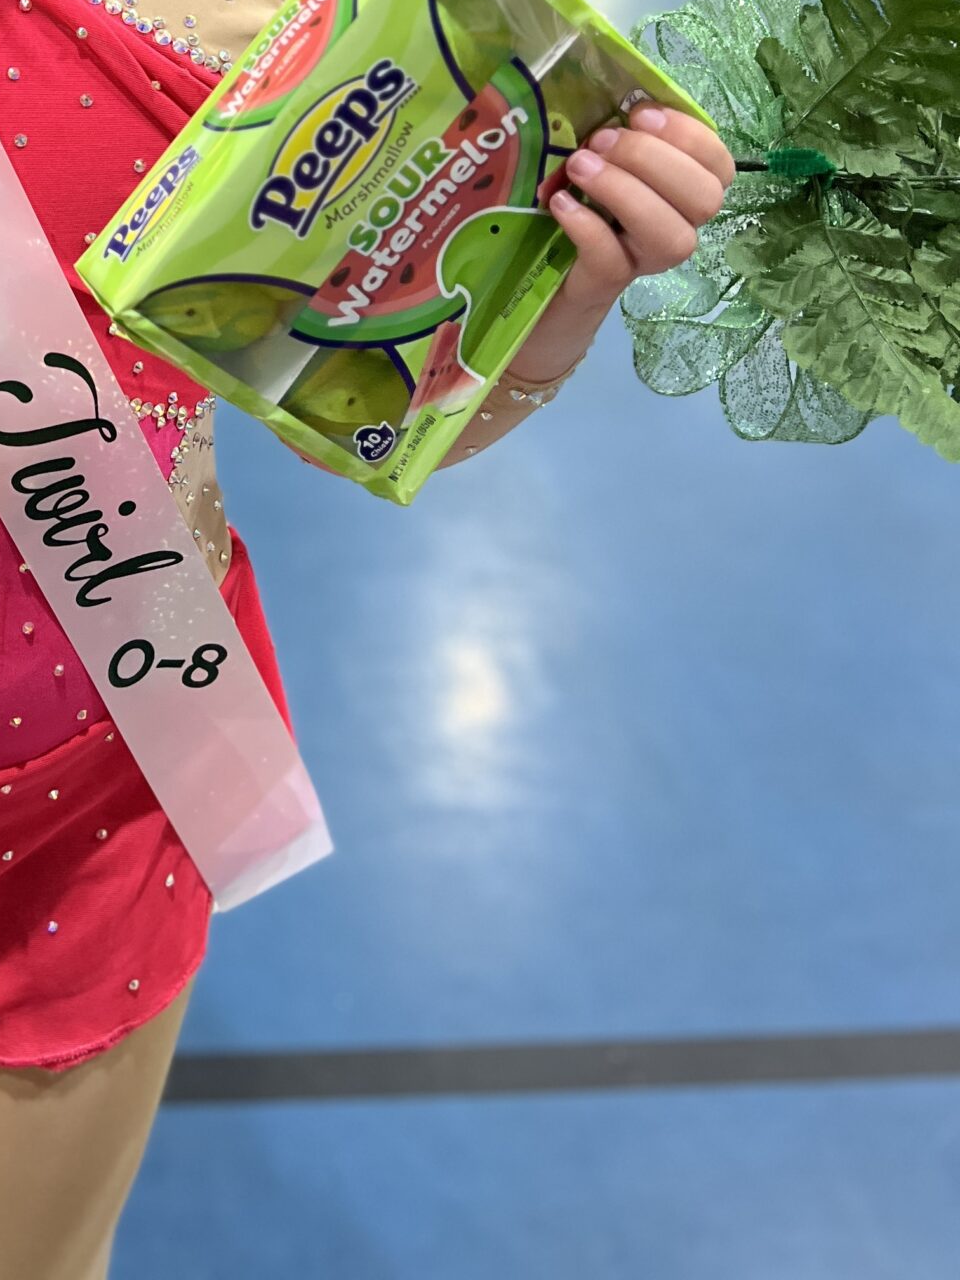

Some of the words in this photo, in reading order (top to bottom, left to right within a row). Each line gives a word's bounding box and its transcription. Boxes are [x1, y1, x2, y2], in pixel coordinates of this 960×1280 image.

[242, 0, 306, 73] SOUR
[250, 58, 416, 238] Peeps
[326, 120, 414, 230] Marshmallow
[103, 144, 201, 263] Peeps
[135, 181, 195, 258] Marshmallow
[327, 105, 530, 328] Watermelon
[347, 137, 460, 257] SOUR
[421, 202, 462, 250] FLAVORED
[362, 432, 382, 449] 10
[107, 639, 228, 691] 0-8
